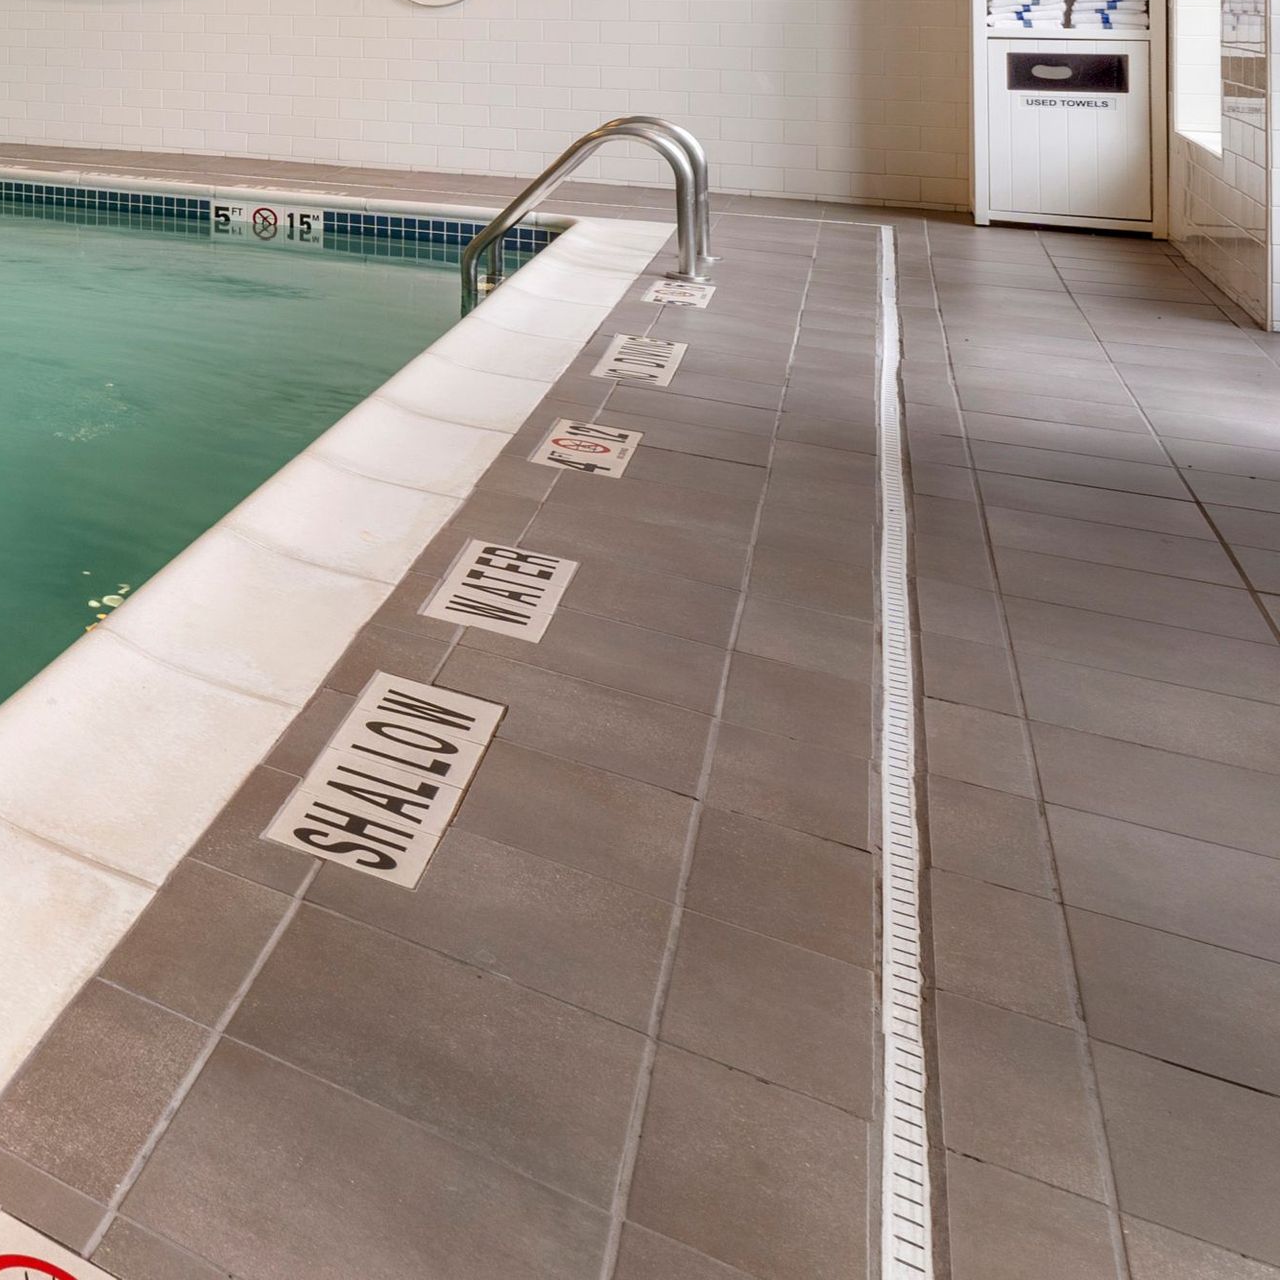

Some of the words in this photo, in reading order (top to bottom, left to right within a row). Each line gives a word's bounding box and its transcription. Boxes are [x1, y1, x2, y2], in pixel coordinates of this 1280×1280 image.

[1061, 100, 1108, 108] TOWELS
[547, 457, 611, 472] 4
[444, 545, 560, 626] WATER
[292, 688, 476, 871] SHALLOW
